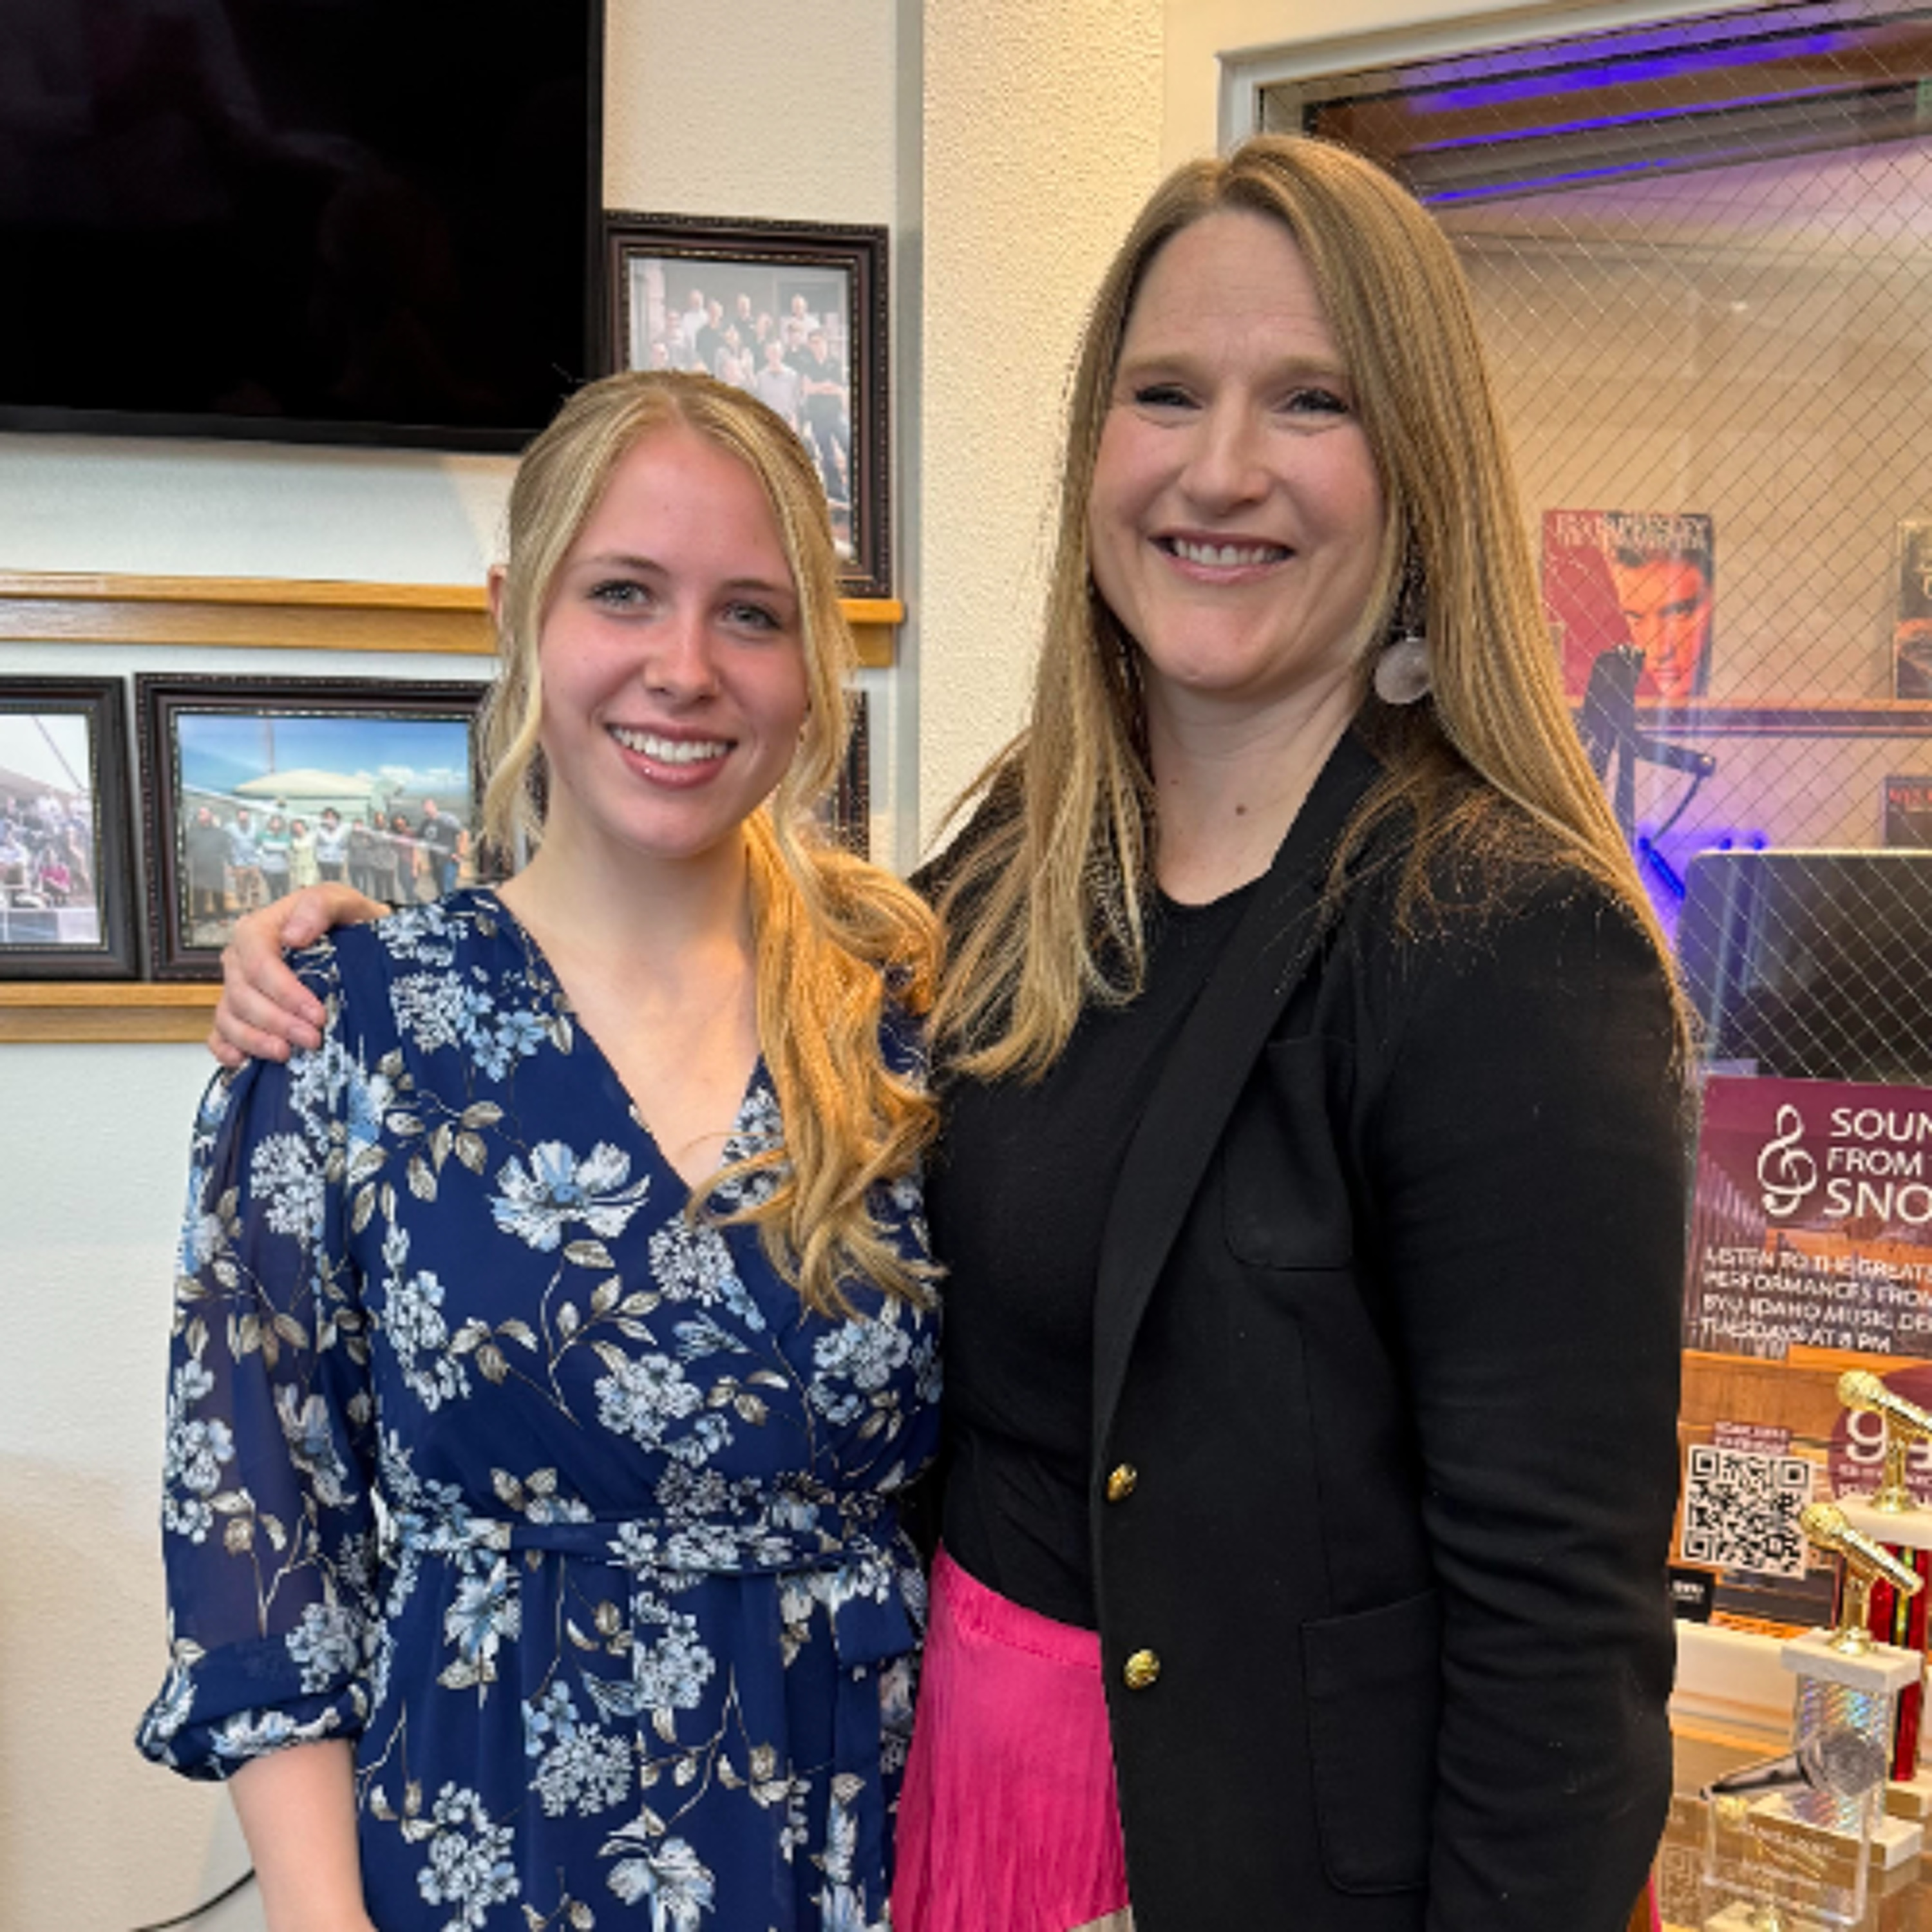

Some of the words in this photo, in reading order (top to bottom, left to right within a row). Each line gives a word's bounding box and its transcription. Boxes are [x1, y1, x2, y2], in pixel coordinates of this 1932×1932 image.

[1827, 1146, 1922, 1177] FROM
[1823, 1177, 1932, 1224] SNO
[1707, 1247, 1774, 1268] LISTEN
[1781, 1251, 1808, 1271] TO
[1814, 1256, 1852, 1274] THE
[1704, 1271, 1871, 1302] PERFORMANCES
[1823, 1305, 1893, 1330] MUSIC
[1898, 1313, 1932, 1334] DE
[1700, 1318, 1807, 1342] TUESDAYS
[1808, 1329, 1835, 1346] AT
[1858, 1333, 1891, 1353] PM
